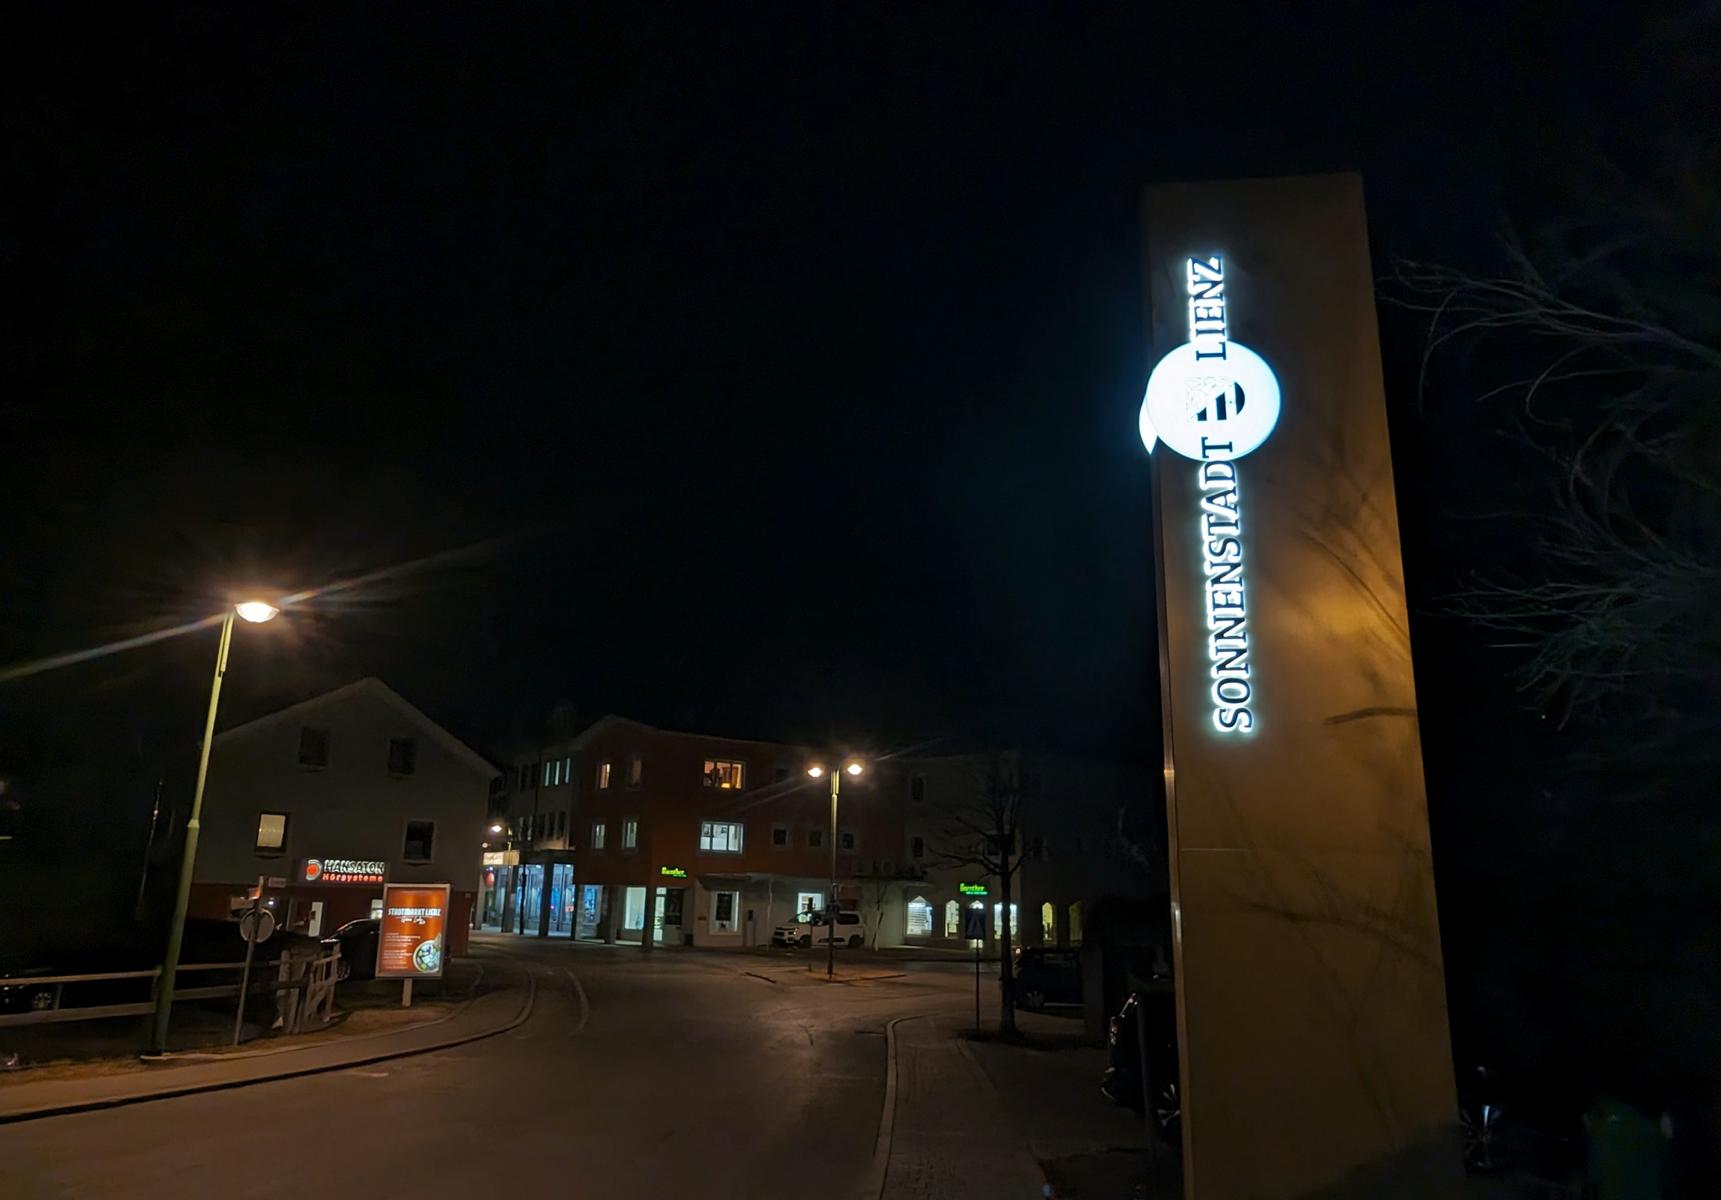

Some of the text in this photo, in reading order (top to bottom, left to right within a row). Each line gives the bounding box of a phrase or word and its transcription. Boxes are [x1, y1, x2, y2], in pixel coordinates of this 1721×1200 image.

[1189, 255, 1252, 731] SONNENSTADT LIENZ
[323, 859, 385, 874] HANSATON
